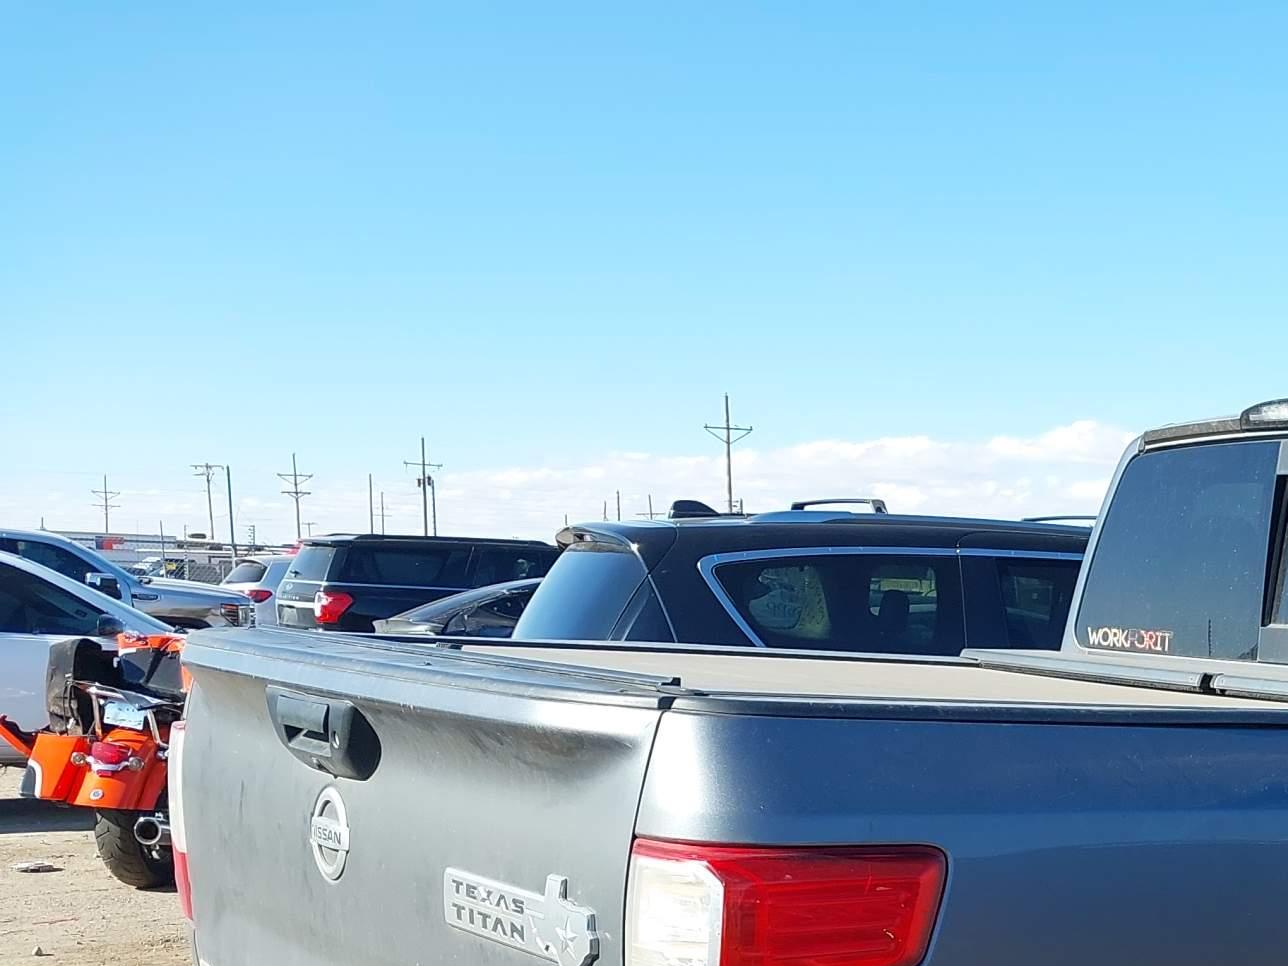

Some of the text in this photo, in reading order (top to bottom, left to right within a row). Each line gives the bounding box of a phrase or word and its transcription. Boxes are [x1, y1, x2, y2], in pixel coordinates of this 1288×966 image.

[313, 824, 342, 846] NISSAN
[452, 879, 525, 915] TEXAS
[452, 902, 525, 942] TITAN
